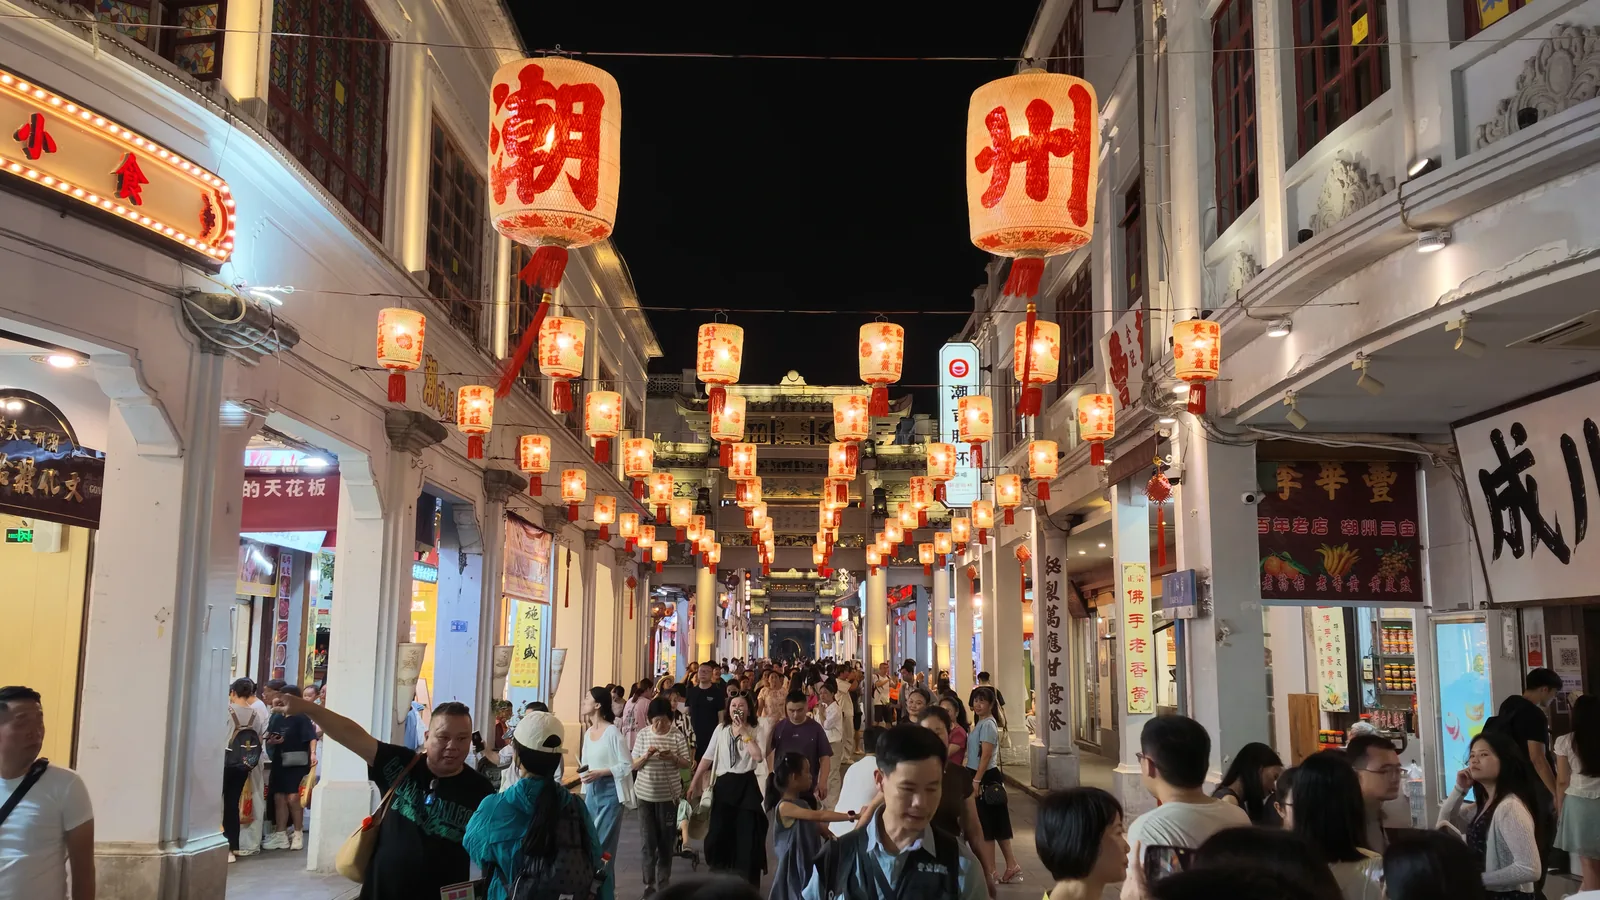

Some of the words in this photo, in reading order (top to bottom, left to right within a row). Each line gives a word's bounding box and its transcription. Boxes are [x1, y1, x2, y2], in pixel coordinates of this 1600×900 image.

[13, 112, 150, 206] 小食
[489, 64, 606, 212] 潮
[974, 83, 1092, 228] 州
[243, 478, 326, 499] 的天花板
[1257, 516, 1329, 536] 百年老店
[1340, 518, 1417, 538] 潮州三宝
